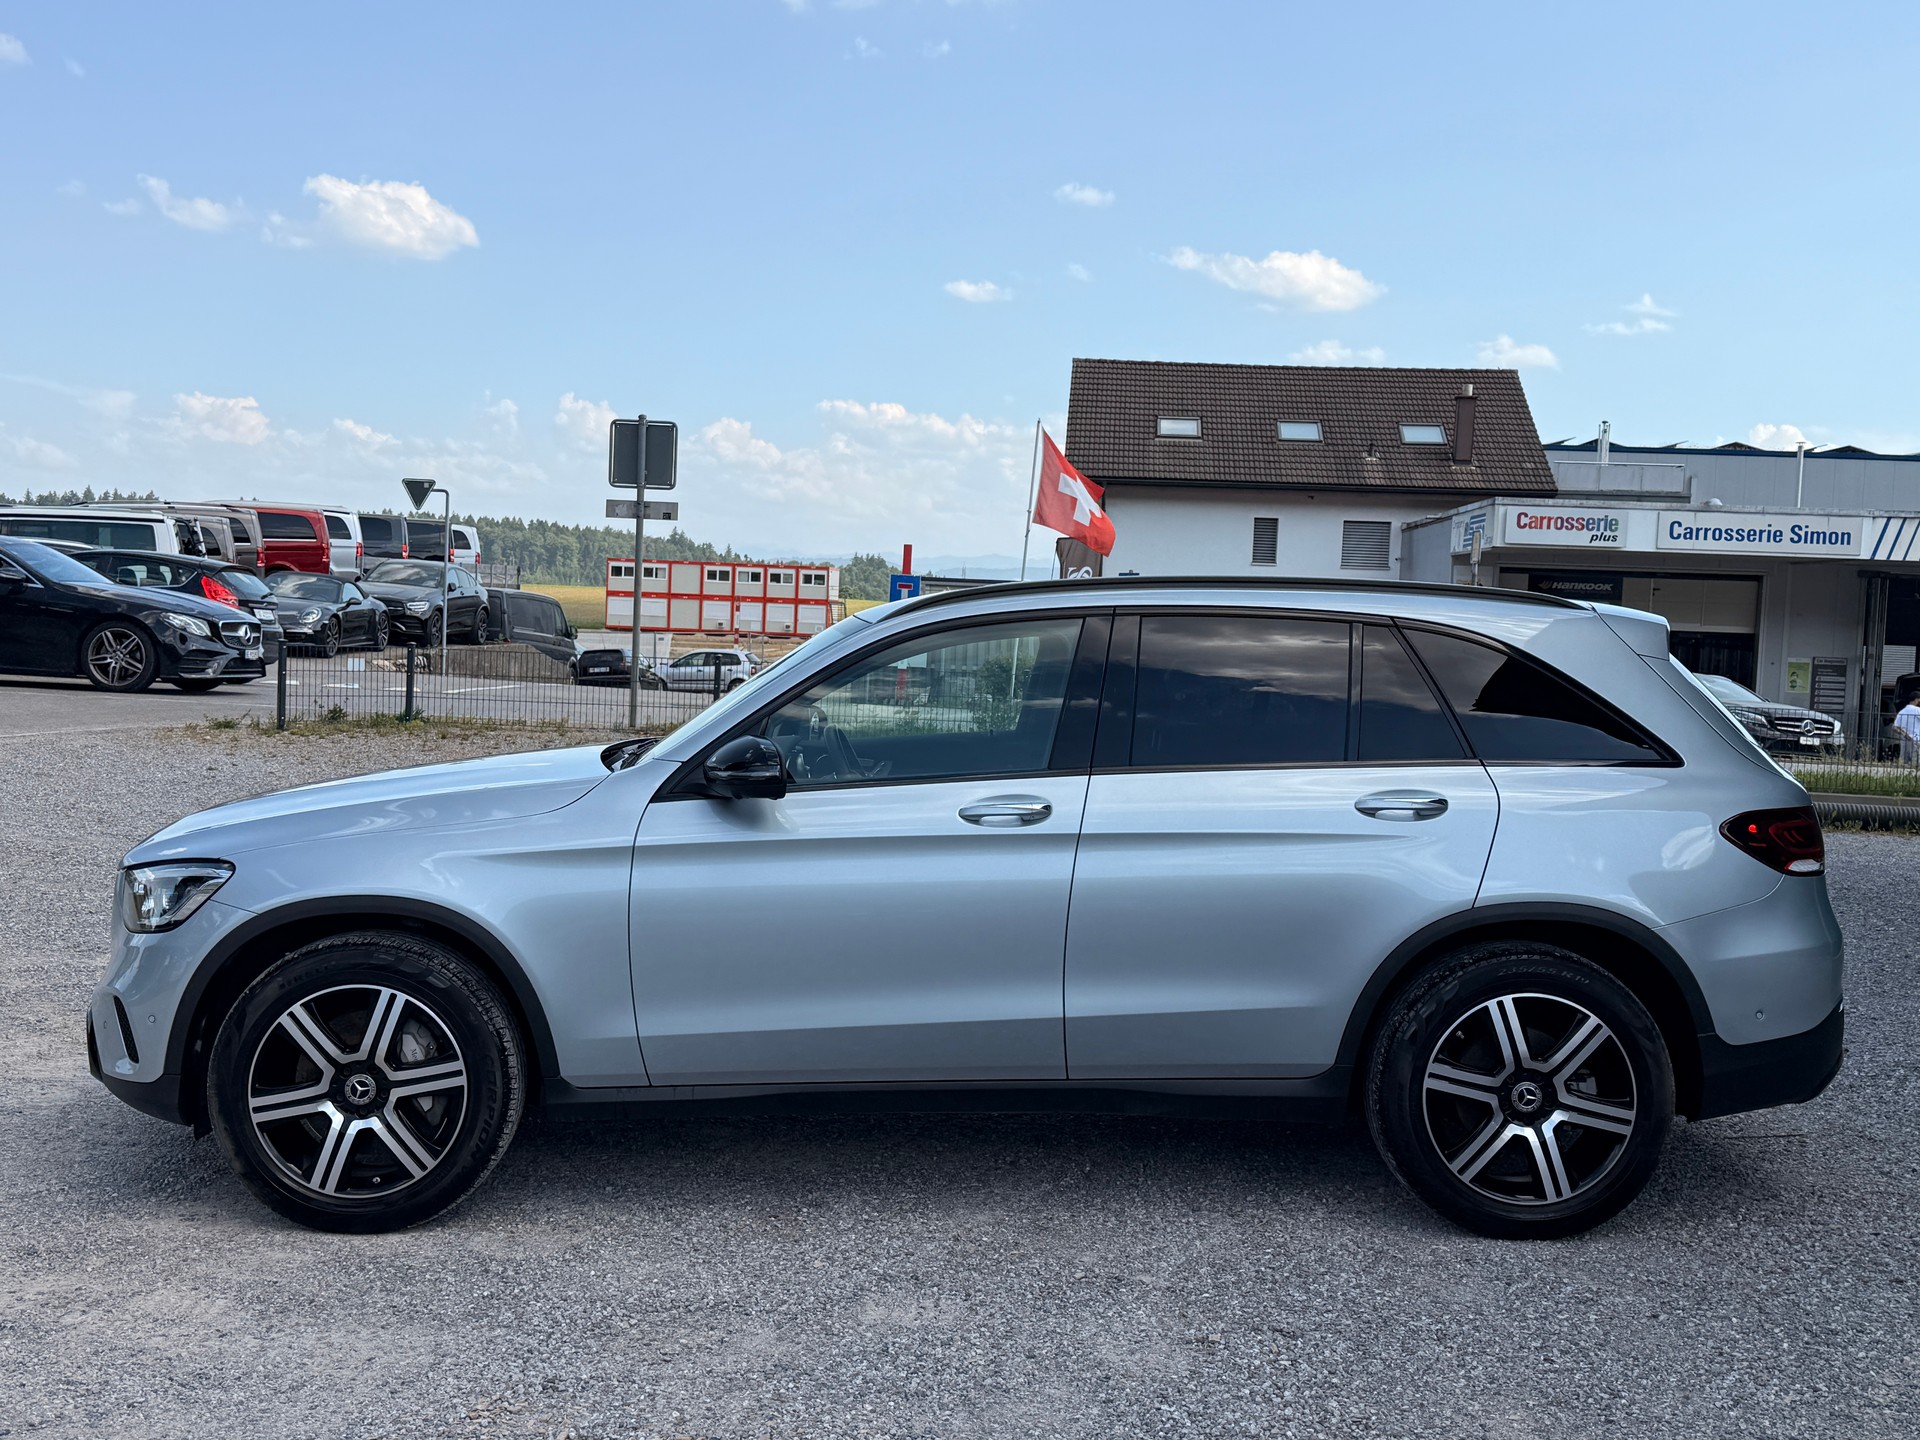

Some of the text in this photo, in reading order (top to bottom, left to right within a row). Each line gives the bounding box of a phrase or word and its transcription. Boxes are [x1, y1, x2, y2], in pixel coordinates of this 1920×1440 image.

[1516, 512, 1619, 533] Carrosserie
[1669, 520, 1851, 545] Carrosserie Simon
[1589, 532, 1619, 543] plus
